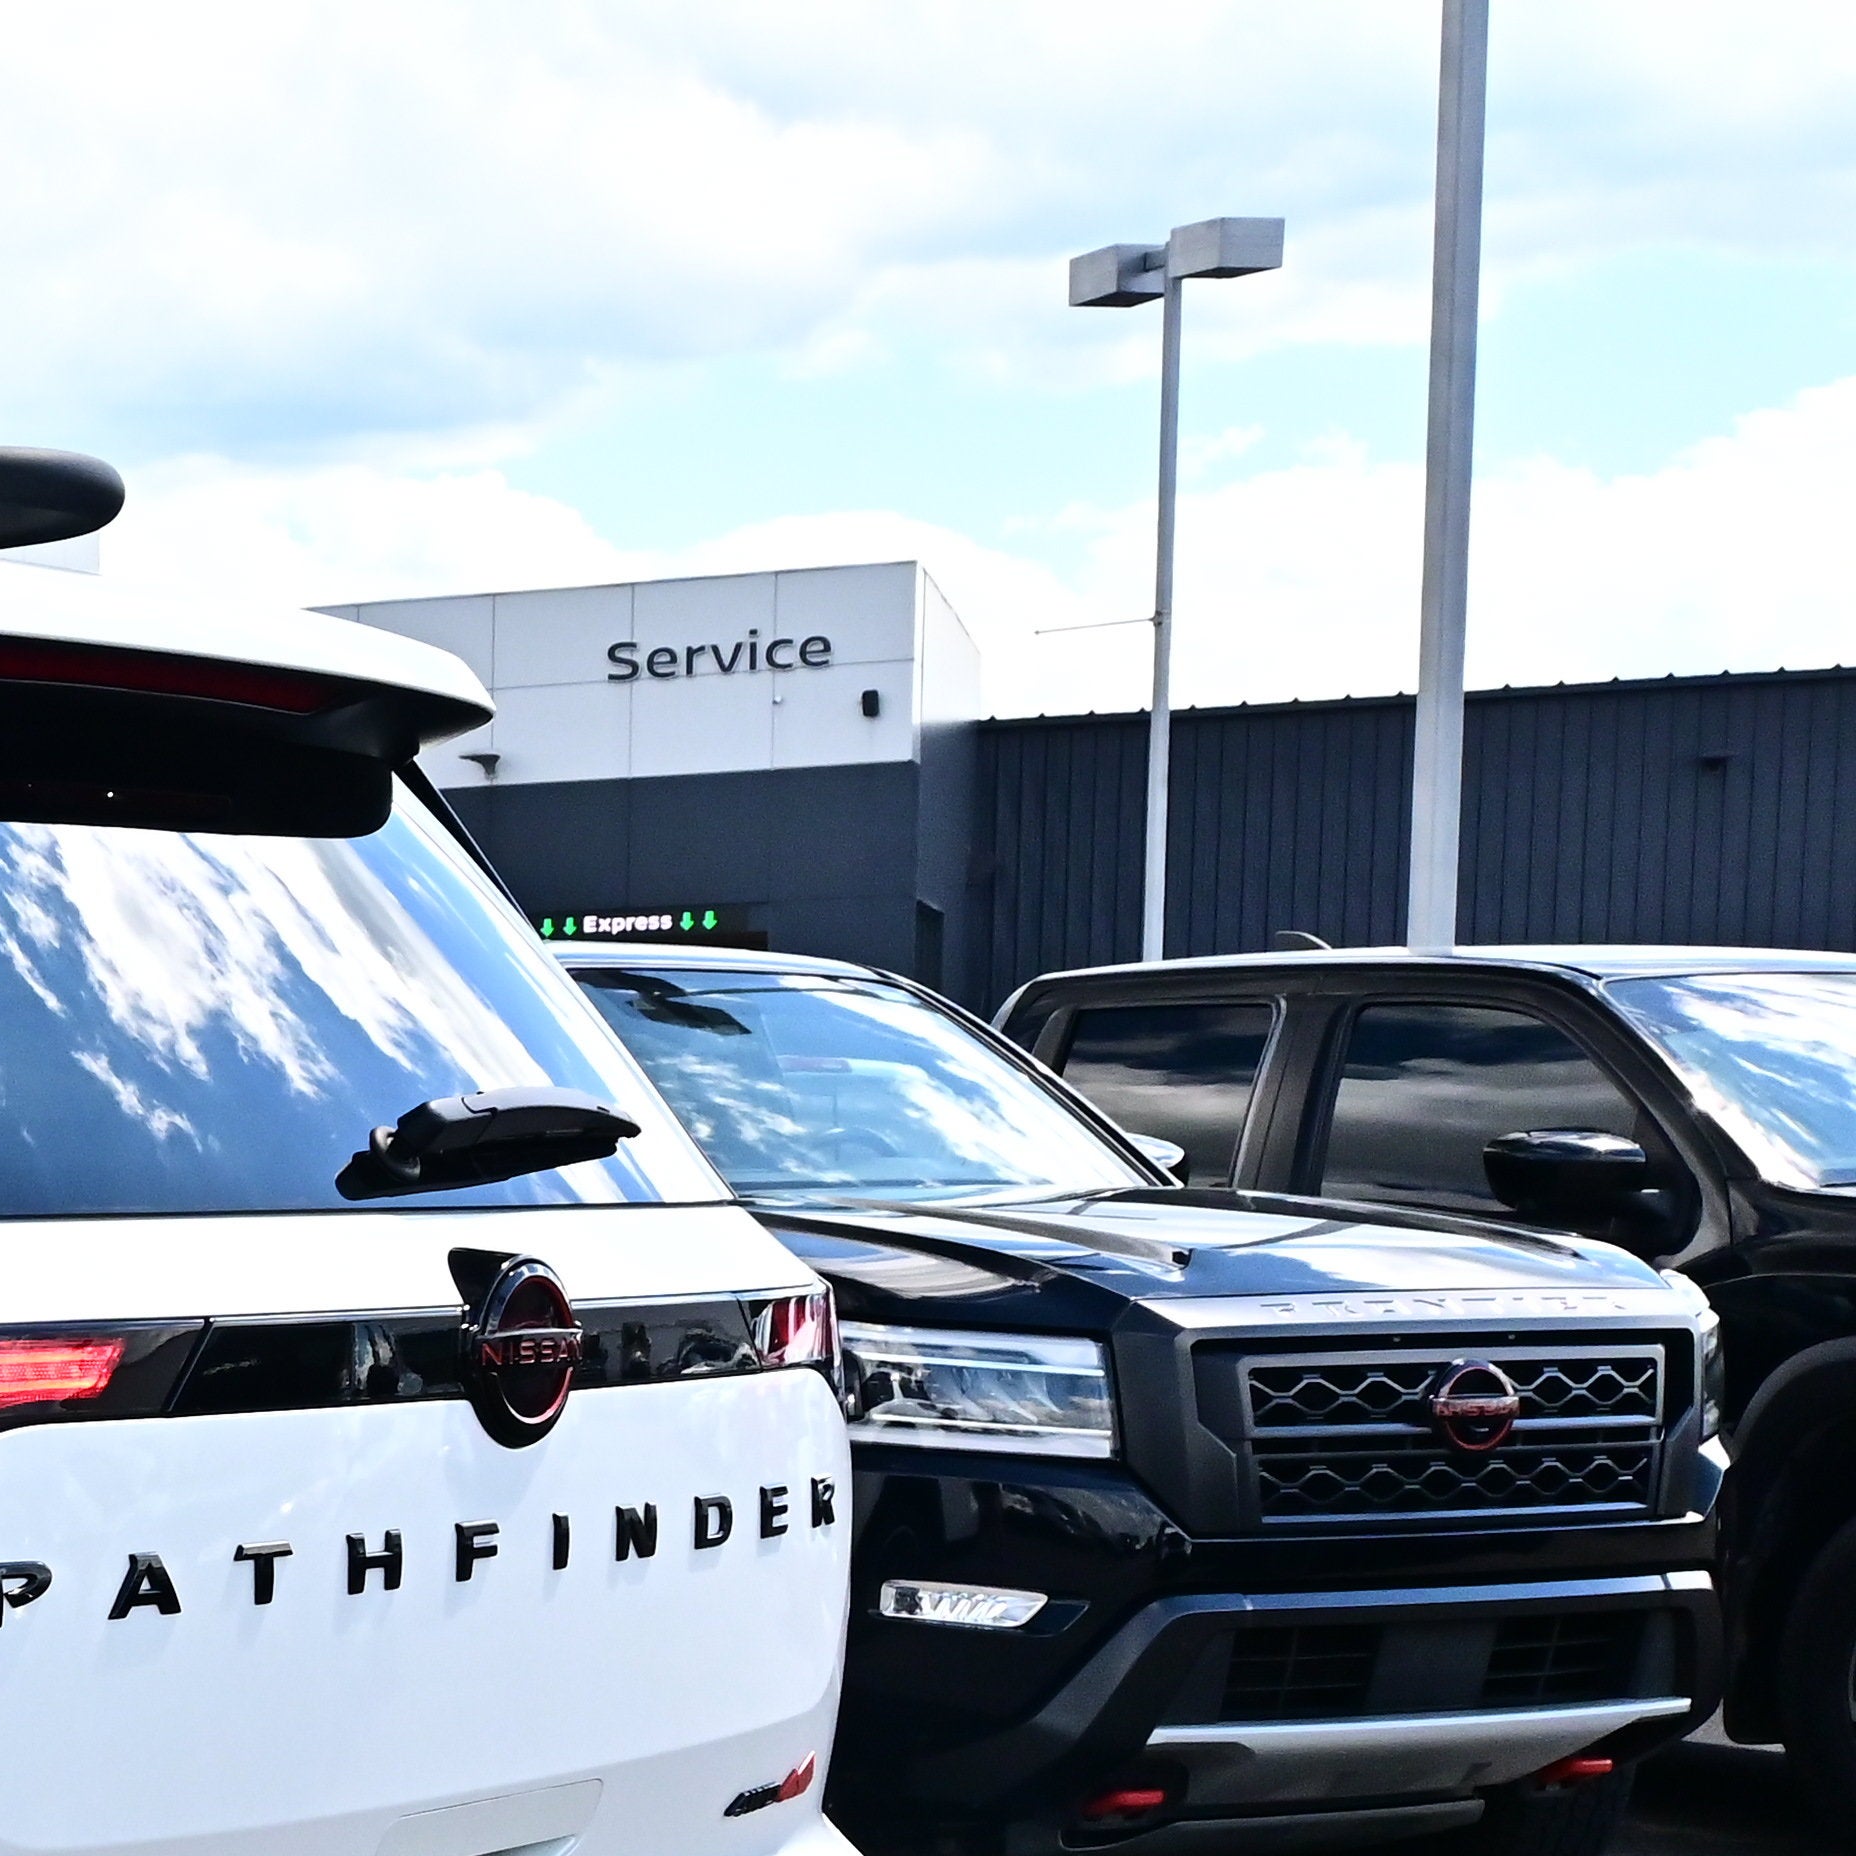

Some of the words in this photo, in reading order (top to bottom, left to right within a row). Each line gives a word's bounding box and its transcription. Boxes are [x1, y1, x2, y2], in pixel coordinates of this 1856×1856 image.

[607, 629, 832, 682] Service
[582, 913, 673, 935] Express
[481, 1337, 583, 1367] NISSAN
